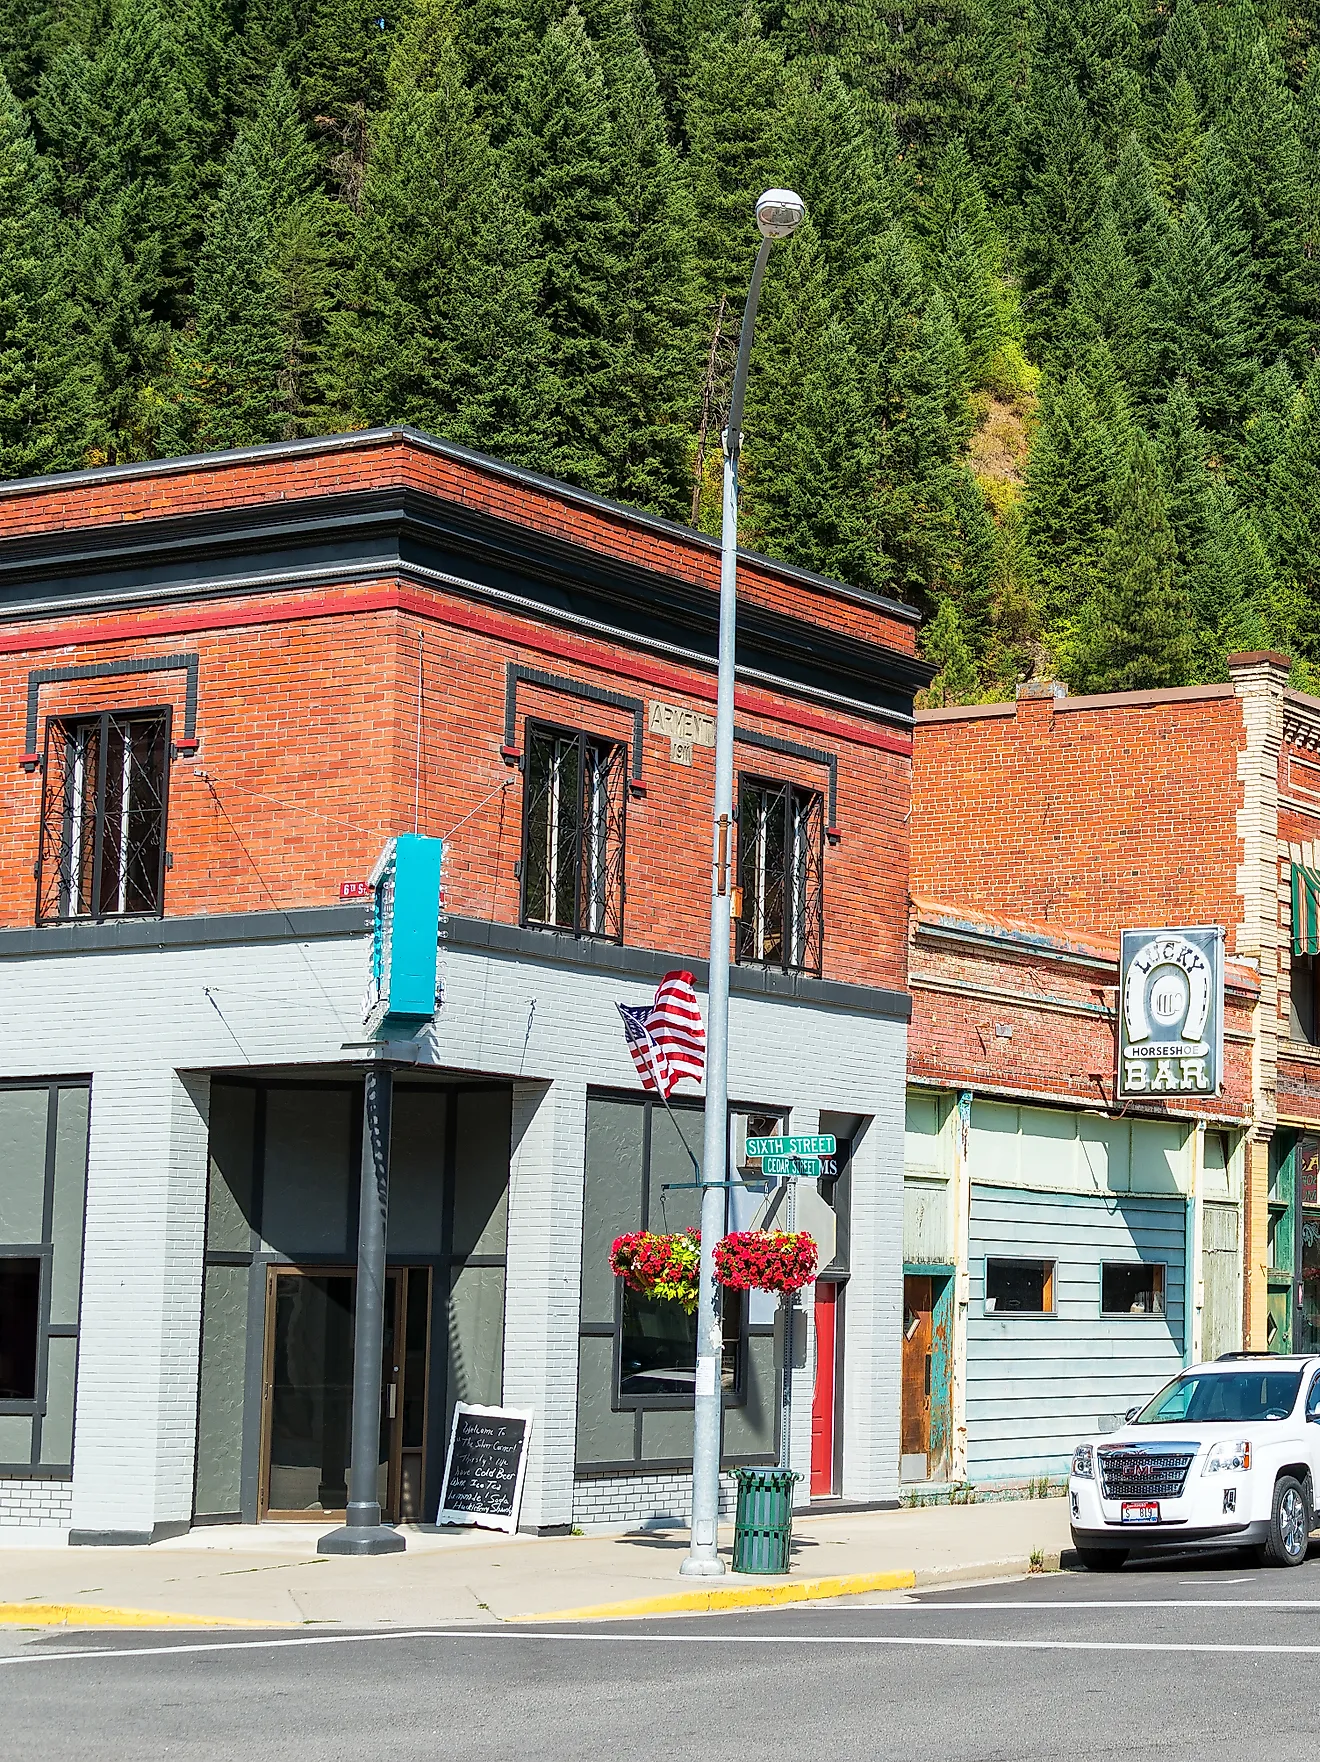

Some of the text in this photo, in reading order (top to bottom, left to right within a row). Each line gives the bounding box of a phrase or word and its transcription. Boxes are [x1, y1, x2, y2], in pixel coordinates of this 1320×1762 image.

[1135, 943, 1205, 974] LUCKY
[1132, 1045, 1199, 1057] HORSESHOE
[1124, 1060, 1209, 1091] BAR
[748, 1137, 832, 1154] SIXTH STREET
[767, 1158, 816, 1174] CEDAR STREET
[475, 1467, 496, 1477] Cold
[496, 1468, 516, 1480] Beer
[1123, 1465, 1162, 1476] GMC
